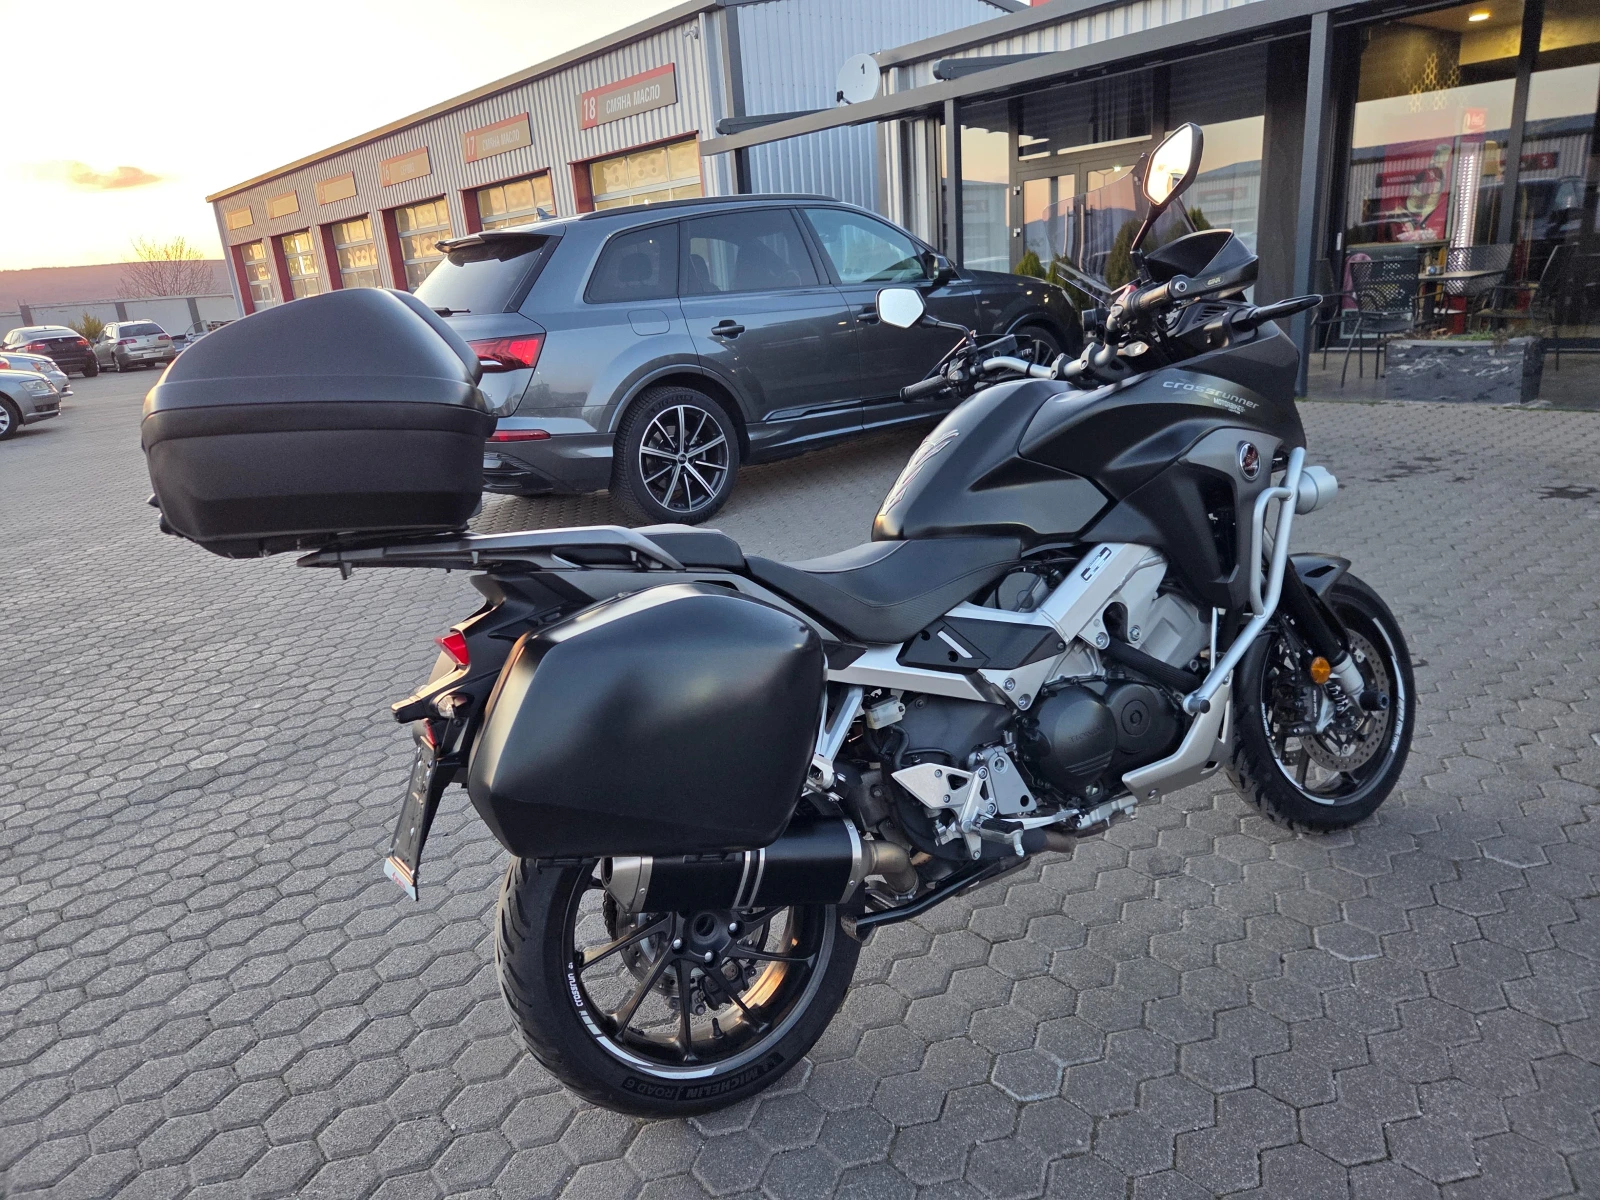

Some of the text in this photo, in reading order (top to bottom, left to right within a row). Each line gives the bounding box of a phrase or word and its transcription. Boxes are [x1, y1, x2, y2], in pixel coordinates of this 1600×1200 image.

[583, 97, 596, 121] 18
[606, 84, 660, 114] СМЯНА МАСЛО
[466, 135, 475, 157] 17
[625, 1069, 760, 1100] MICHELIN ROAD 6
